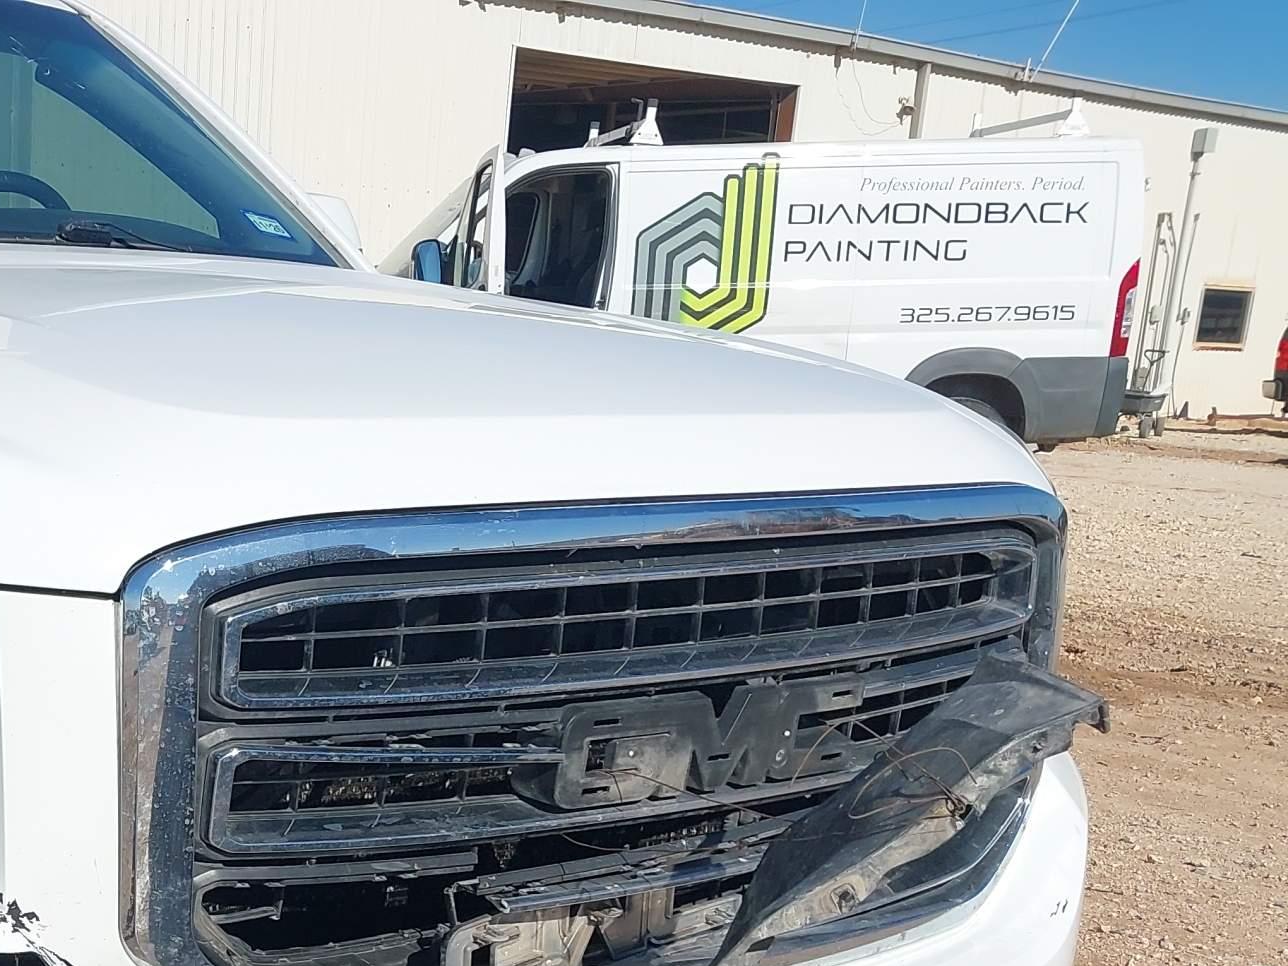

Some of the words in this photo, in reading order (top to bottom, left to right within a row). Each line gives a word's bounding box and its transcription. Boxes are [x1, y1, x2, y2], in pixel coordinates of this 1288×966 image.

[860, 177, 955, 195] Professional
[959, 177, 1025, 191] Painters.
[1031, 176, 1086, 191] Period.
[787, 201, 1090, 225] DIAMONDBACK
[783, 239, 968, 262] PAINTING
[899, 304, 1076, 323] 325.267.9615
